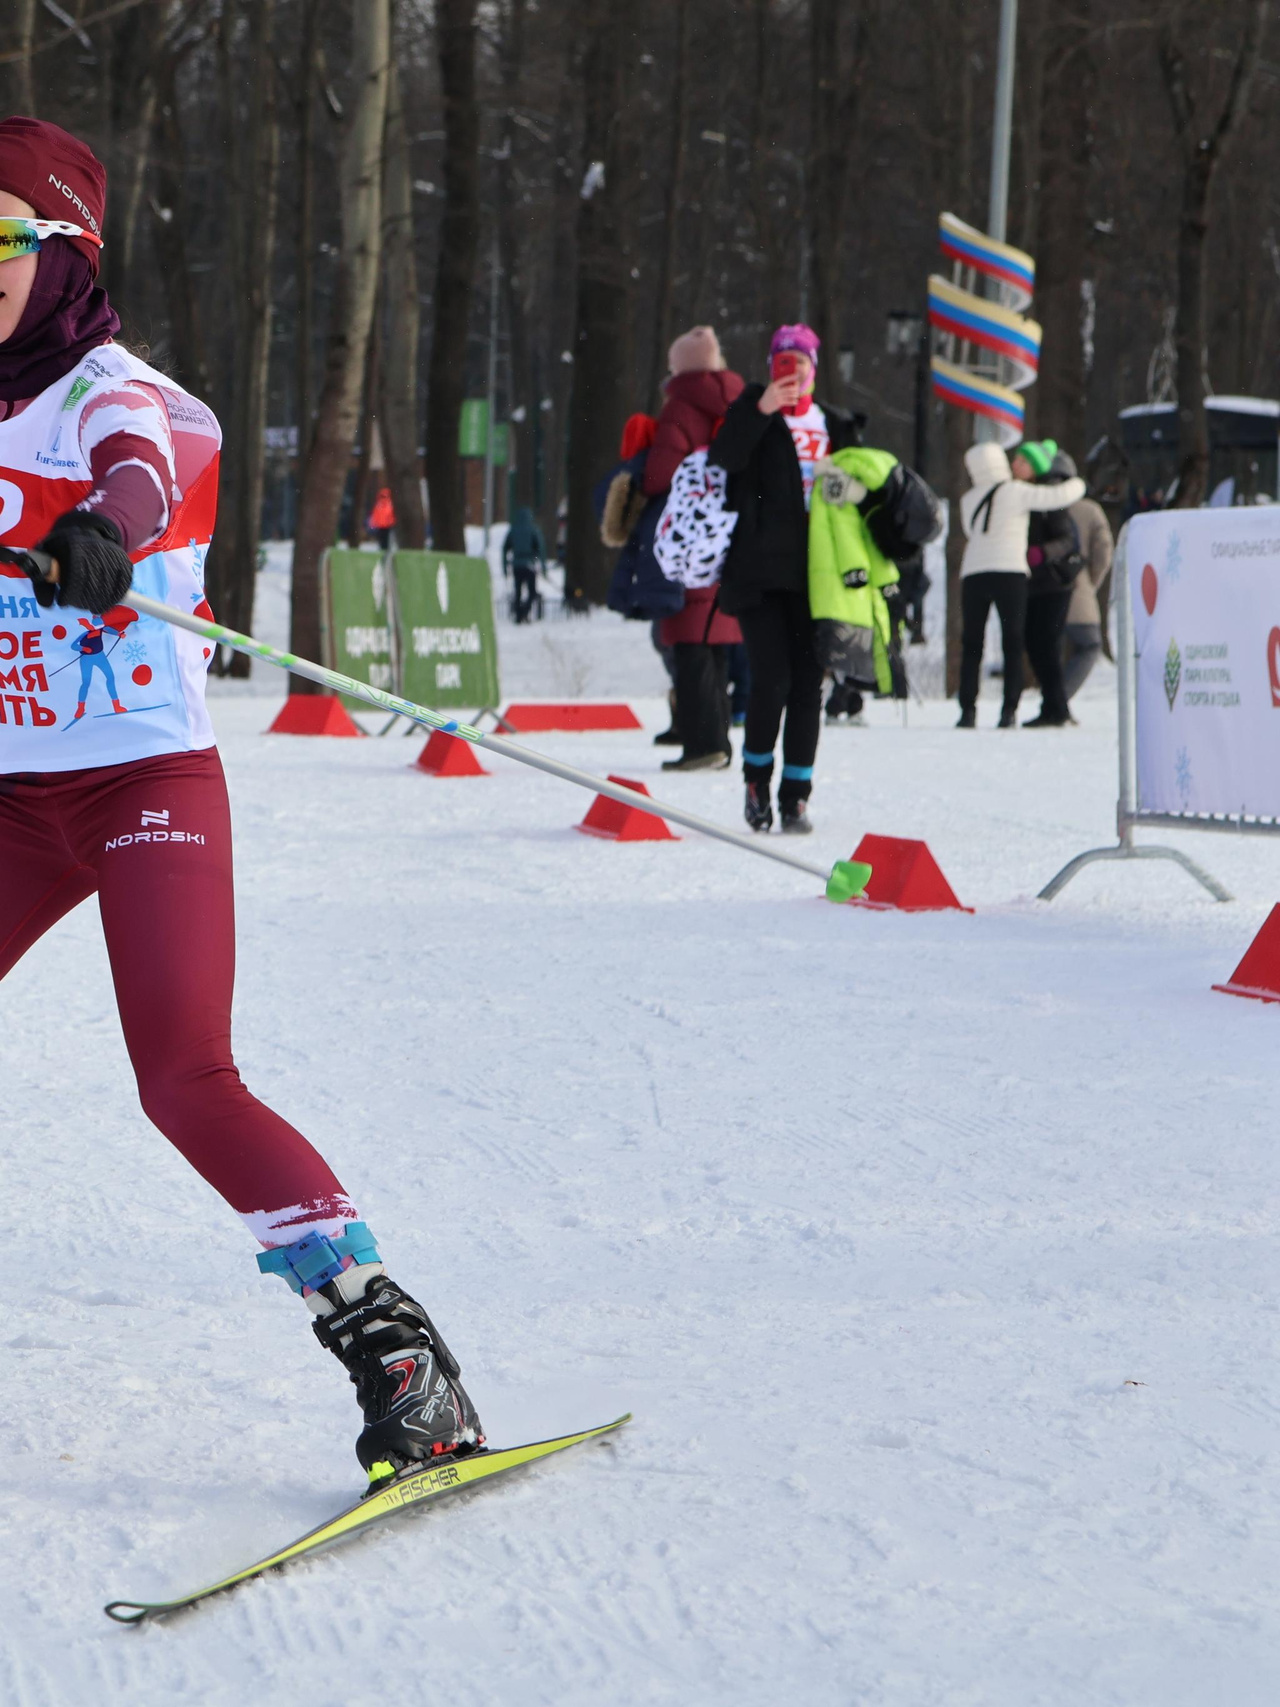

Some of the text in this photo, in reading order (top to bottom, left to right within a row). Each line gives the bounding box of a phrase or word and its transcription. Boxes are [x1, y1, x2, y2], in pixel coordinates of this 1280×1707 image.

[105, 830, 205, 852] NORDSKI
[329, 1292, 391, 1331] SPINE
[420, 1373, 448, 1424] SPINE
[399, 1467, 461, 1504] FISCHER
